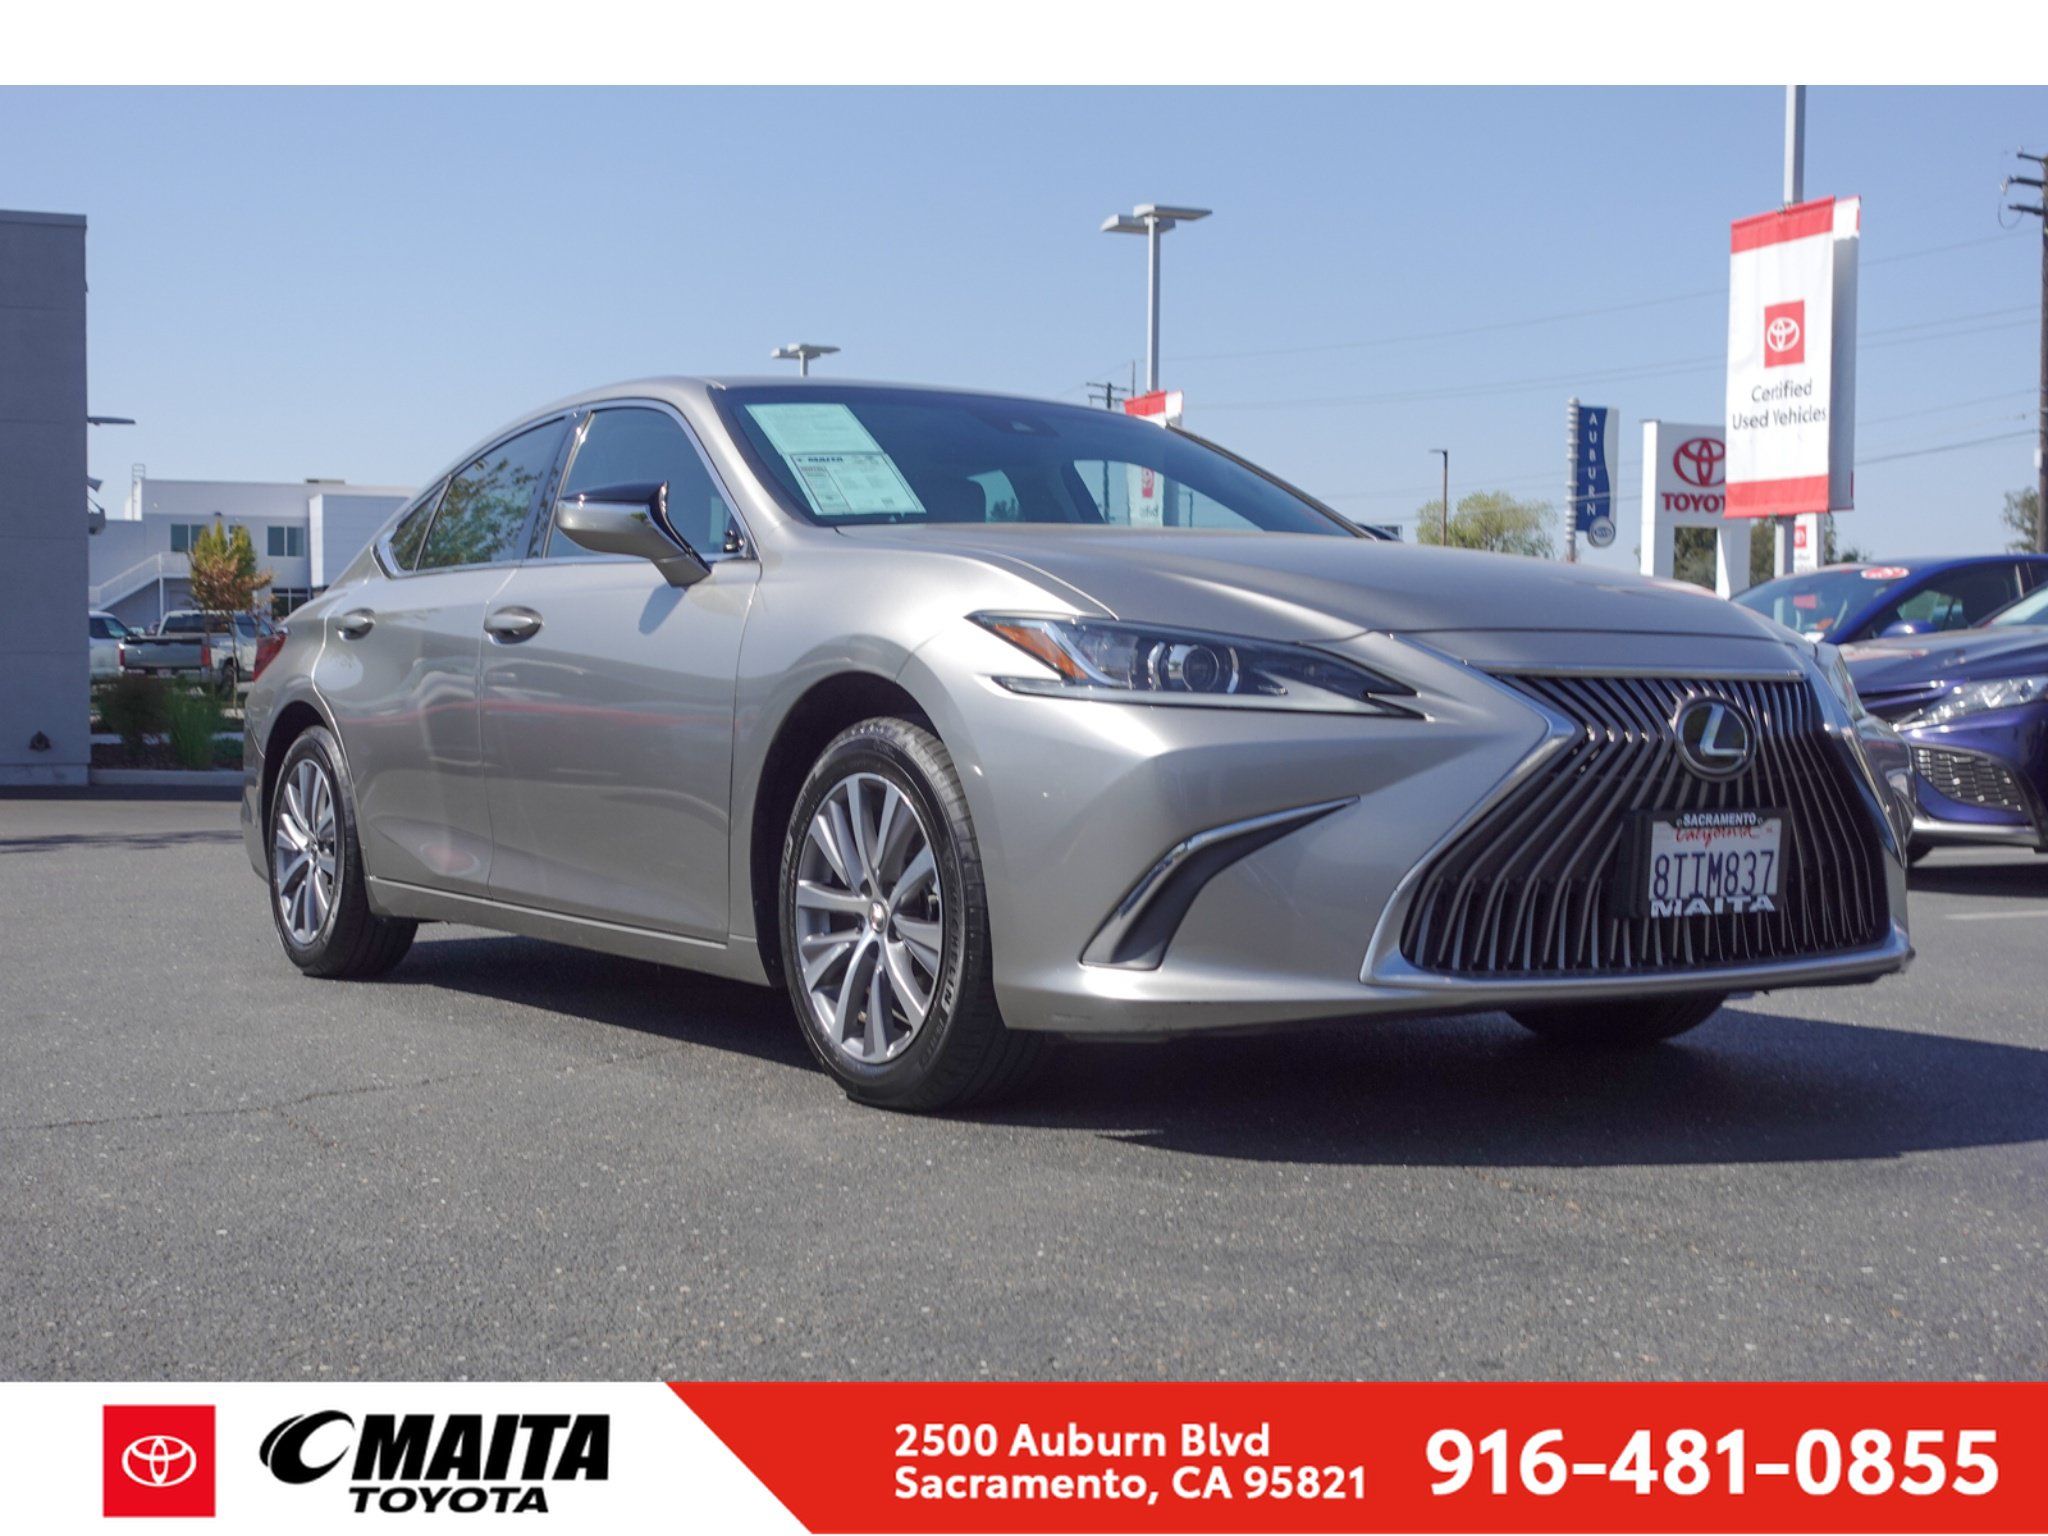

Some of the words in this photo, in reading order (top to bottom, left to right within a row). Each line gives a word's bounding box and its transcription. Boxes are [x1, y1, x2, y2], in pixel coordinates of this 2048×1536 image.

[1751, 377, 1812, 402] Certified
[1732, 410, 1769, 430] Used
[1772, 405, 1826, 426] Vehicles
[1586, 412, 1598, 516] AUBURN
[1682, 812, 1757, 827] SACRAMENTO
[1653, 849, 1775, 900] 8TIM837
[1650, 894, 1775, 918] MAITA
